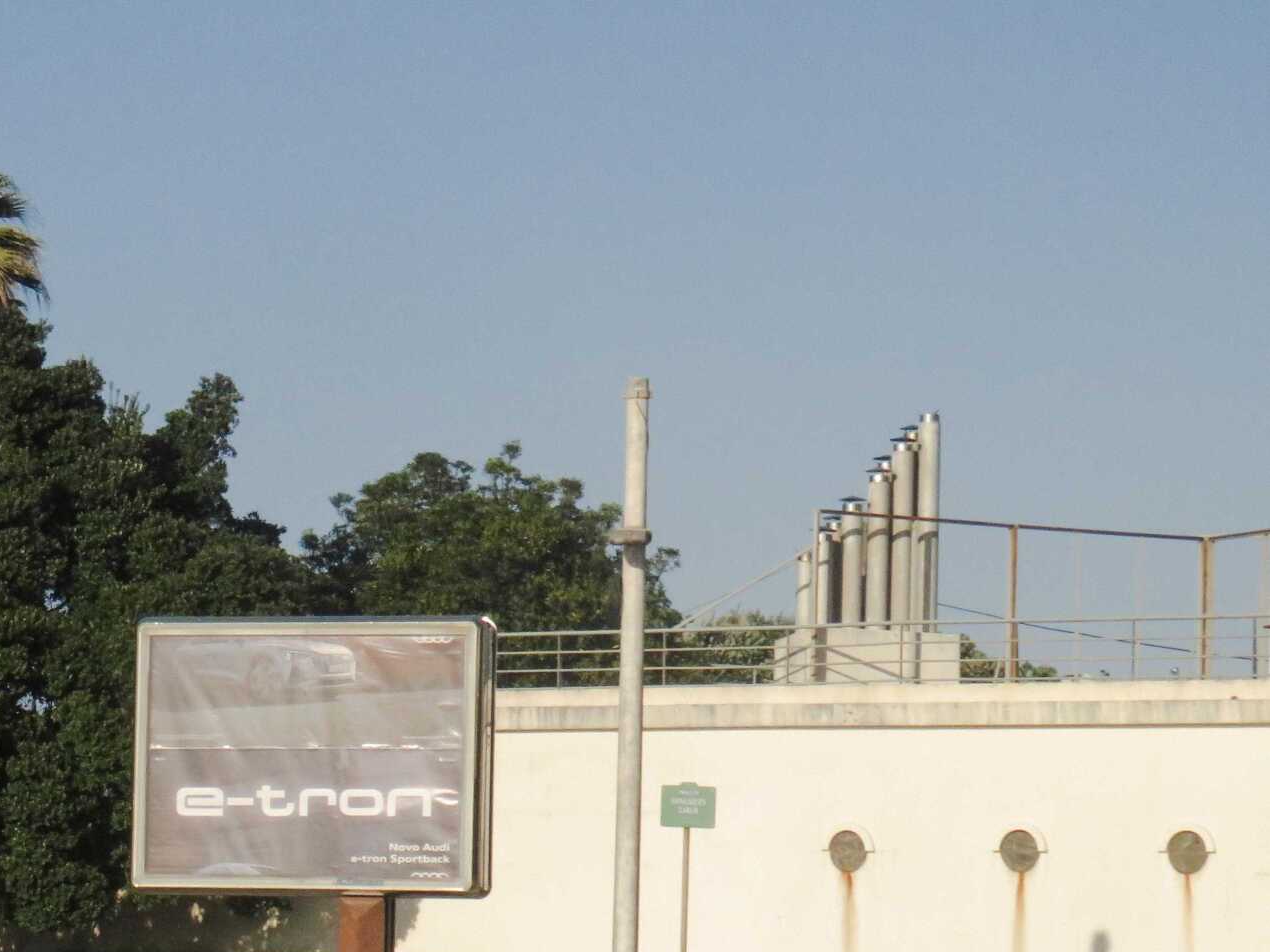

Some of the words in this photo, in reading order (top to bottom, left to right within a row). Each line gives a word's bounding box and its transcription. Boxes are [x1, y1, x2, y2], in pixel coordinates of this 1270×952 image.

[176, 785, 432, 817] e-tron
[388, 843, 420, 852] Novo
[422, 843, 450, 852] Audi
[350, 855, 388, 863] e-tron
[390, 854, 451, 865] Sportback
